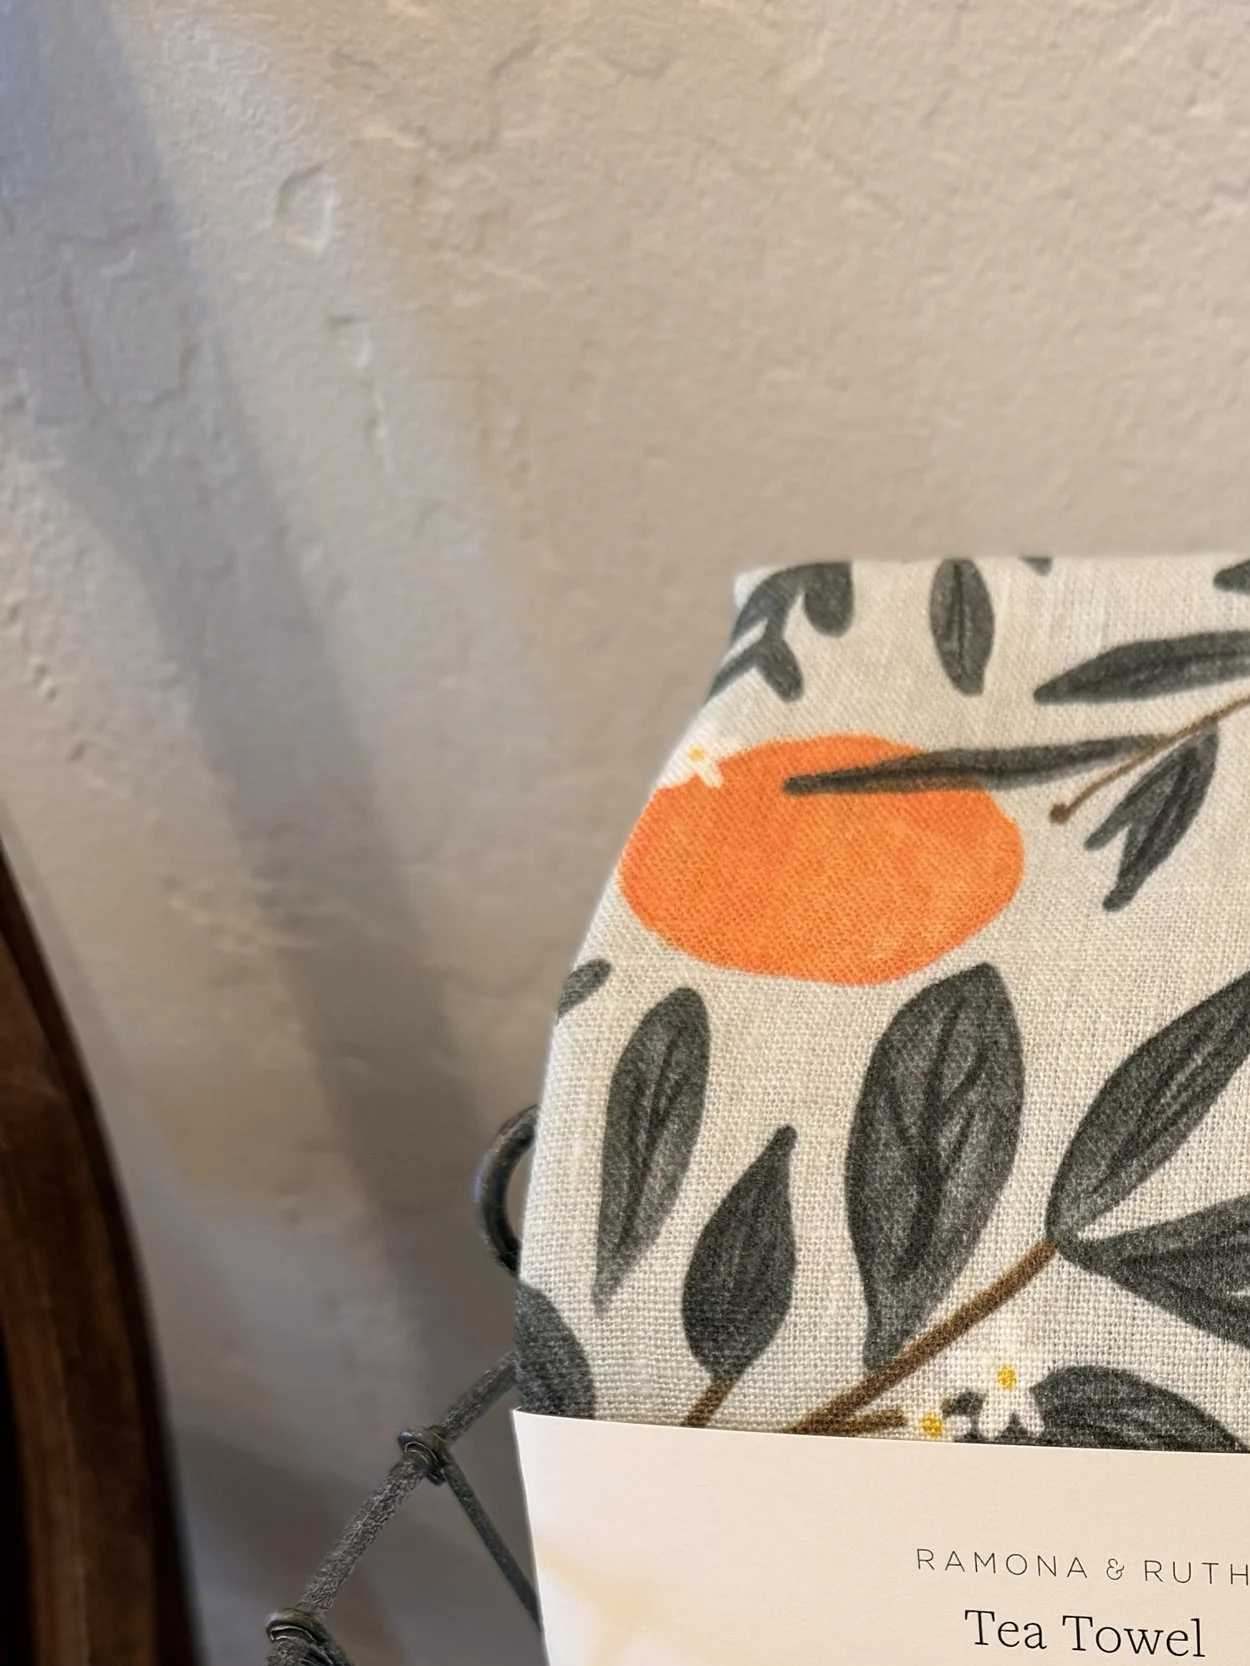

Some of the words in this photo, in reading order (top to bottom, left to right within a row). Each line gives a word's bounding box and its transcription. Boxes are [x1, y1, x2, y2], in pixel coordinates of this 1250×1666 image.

[916, 1548, 1088, 1579] RAMONA
[1105, 1557, 1125, 1581] &
[1143, 1559, 1249, 1587] RUTH
[964, 1609, 1048, 1650] Tea
[1061, 1614, 1206, 1658] Towel
